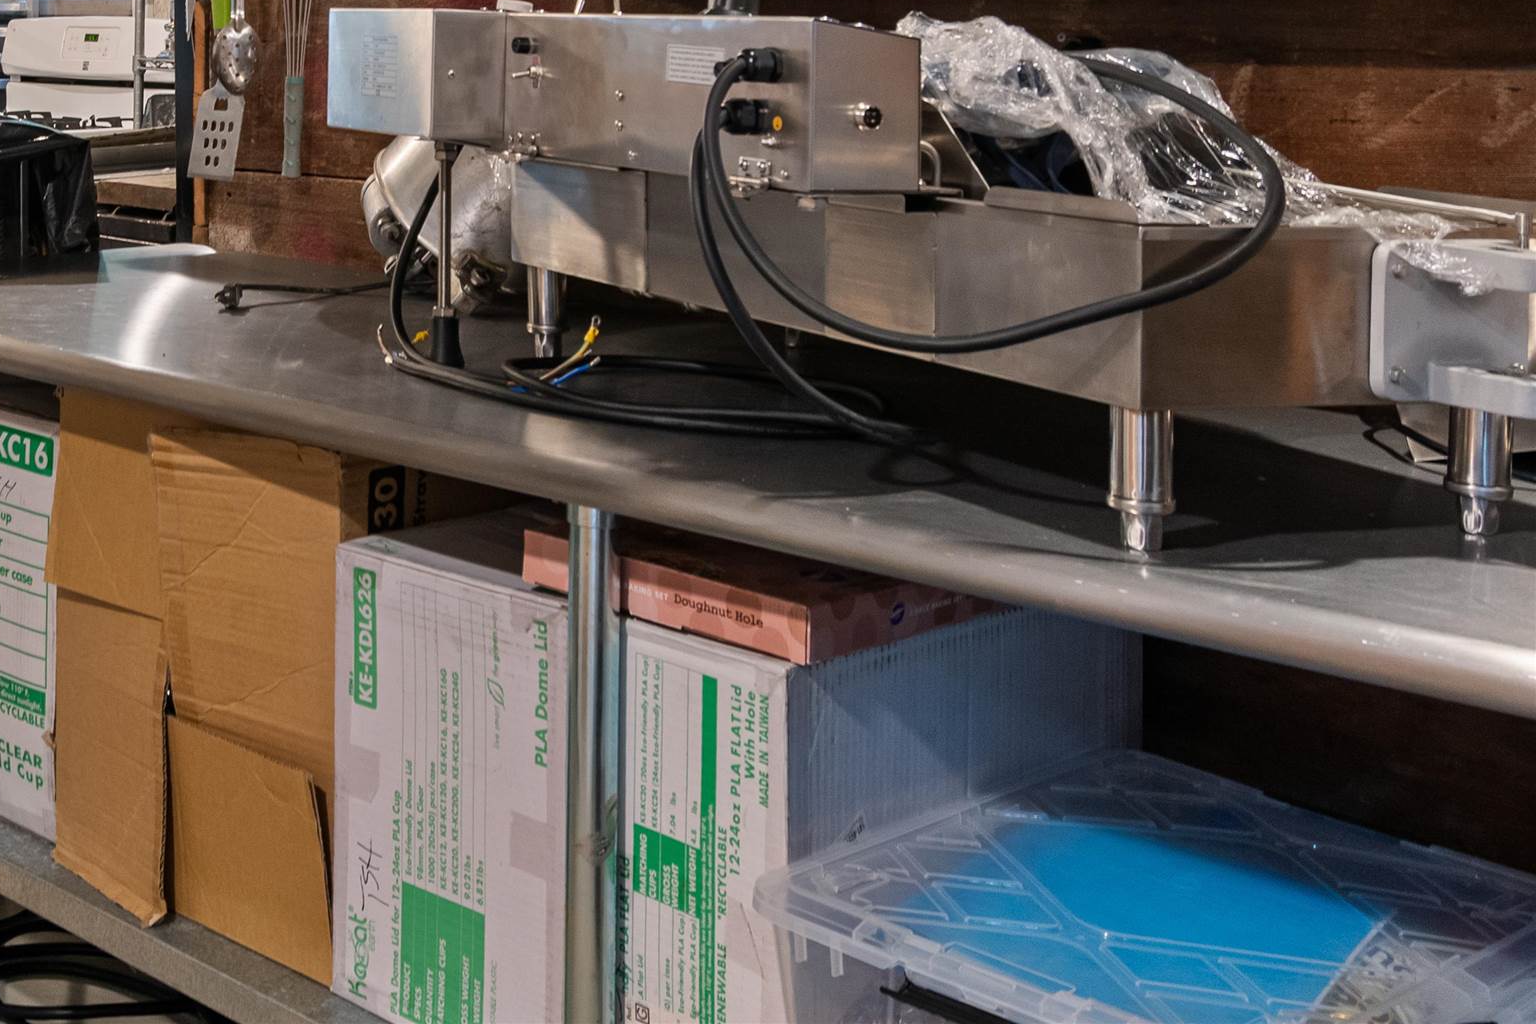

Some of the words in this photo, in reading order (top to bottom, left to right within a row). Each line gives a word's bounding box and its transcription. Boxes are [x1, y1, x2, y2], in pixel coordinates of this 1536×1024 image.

[11, 568, 34, 587] case
[629, 584, 653, 598] AKING
[673, 593, 733, 620] Doughnut
[735, 610, 764, 629] Hole
[358, 572, 373, 705] KE-KDL626
[532, 618, 548, 652] Lid
[534, 658, 549, 722] Dome
[641, 679, 649, 697] PLA
[641, 698, 649, 753] Eco-Friendly
[744, 690, 756, 733] Hole
[758, 694, 769, 745] TAIWAN
[534, 728, 548, 769] PLA
[653, 703, 661, 758] Eco-Friendly
[404, 759, 413, 777] Lid
[744, 738, 755, 780] With
[758, 749, 769, 767] IN
[16, 764, 44, 792] Cup
[404, 778, 413, 810] Dome
[730, 764, 741, 798] PLA
[758, 770, 769, 809] MADE
[391, 789, 403, 815] Cup
[416, 784, 425, 814] Clear
[391, 818, 401, 842] PLA
[404, 812, 414, 876] Eco-Friendly
[728, 802, 741, 876] 12-24oz
[391, 846, 401, 900] 12-24oz
[427, 856, 436, 885] 1000
[638, 833, 648, 895] MATCHING
[688, 847, 697, 893] WEIGHT
[648, 869, 657, 898] CUPS
[663, 864, 671, 905] GROSS
[671, 863, 679, 909] WEIGHT
[391, 905, 400, 925] for
[619, 886, 630, 922] FLAT
[688, 894, 697, 915] NET
[391, 928, 400, 947] Lid
[438, 937, 447, 968] CUPS
[618, 924, 630, 954] PLA
[689, 943, 698, 961] PLA
[390, 950, 400, 988] Dome
[402, 960, 412, 1014] PRODUCT
[461, 954, 470, 1000] WEIGHT
[677, 958, 686, 1014] Eco-Friendly
[390, 992, 400, 1015] PLA
[413, 986, 423, 1021] SPECS
[425, 968, 434, 1024] QUANTITY
[473, 978, 482, 1024] WEIGHT
